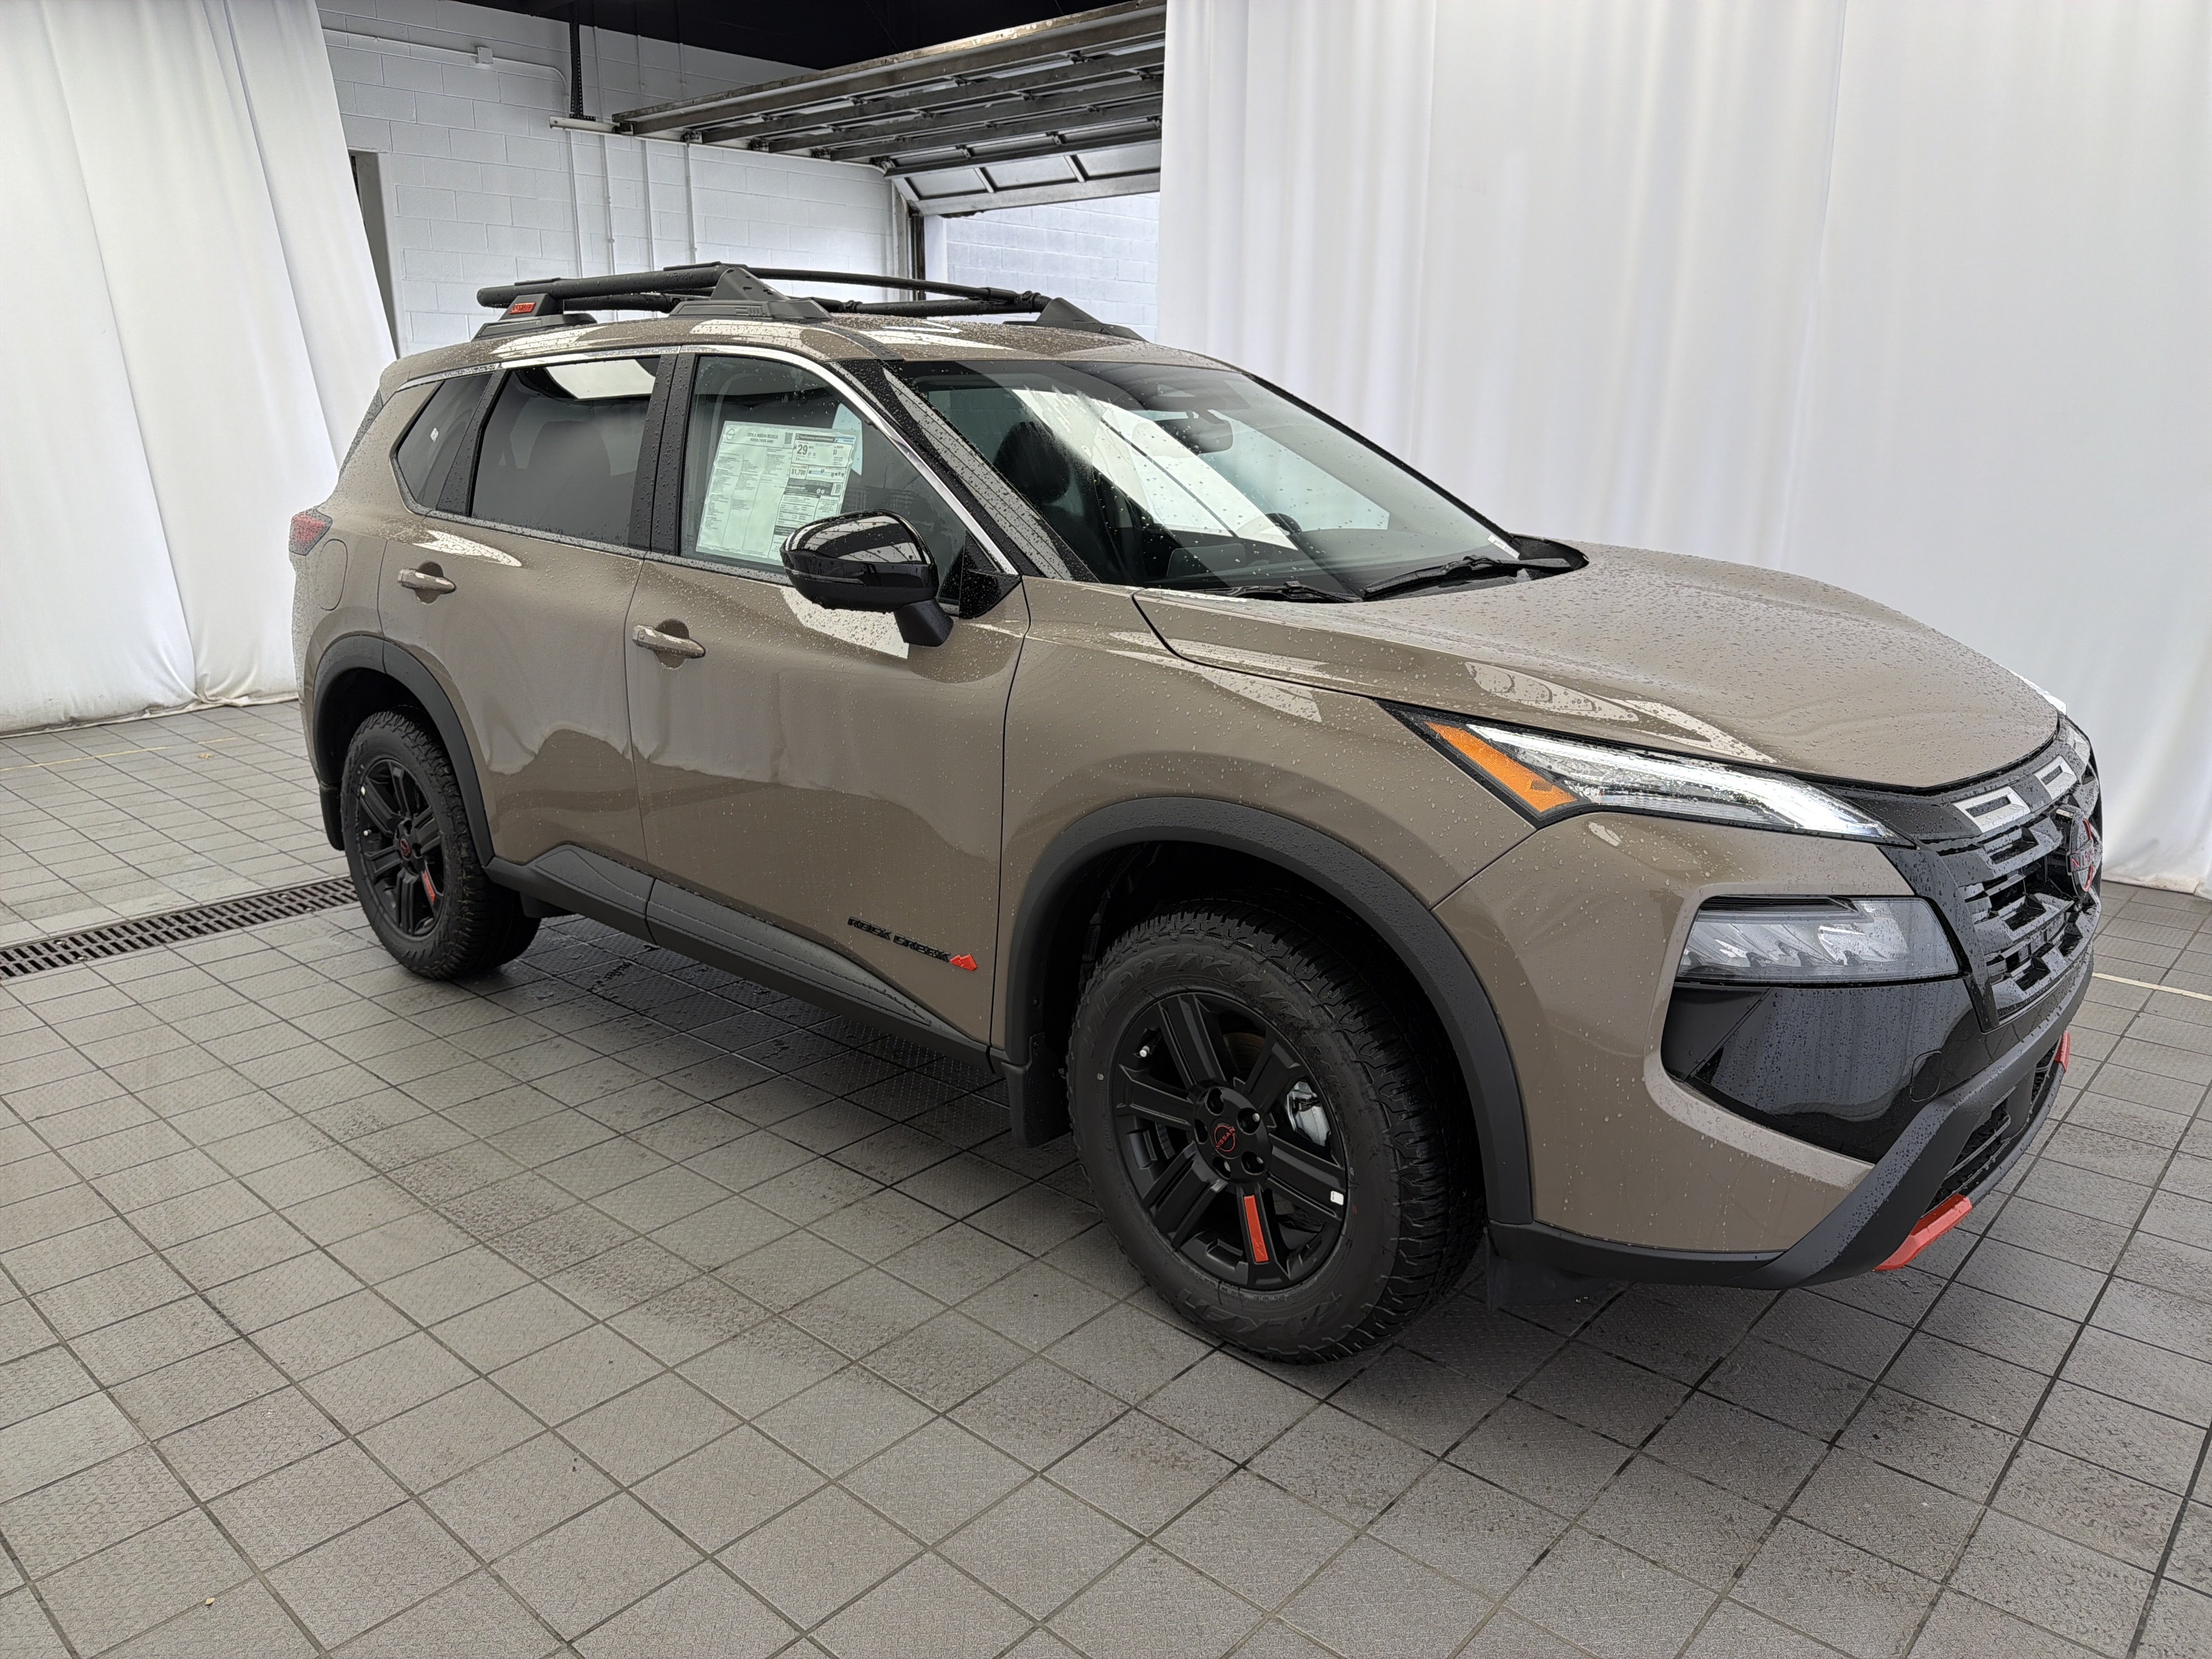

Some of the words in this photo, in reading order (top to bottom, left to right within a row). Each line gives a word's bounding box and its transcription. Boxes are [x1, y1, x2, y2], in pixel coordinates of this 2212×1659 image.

[797, 444, 808, 455] 29
[847, 916, 892, 940] ROCK
[893, 933, 951, 962] CREEK
[1215, 1126, 1235, 1149] NISSAN
